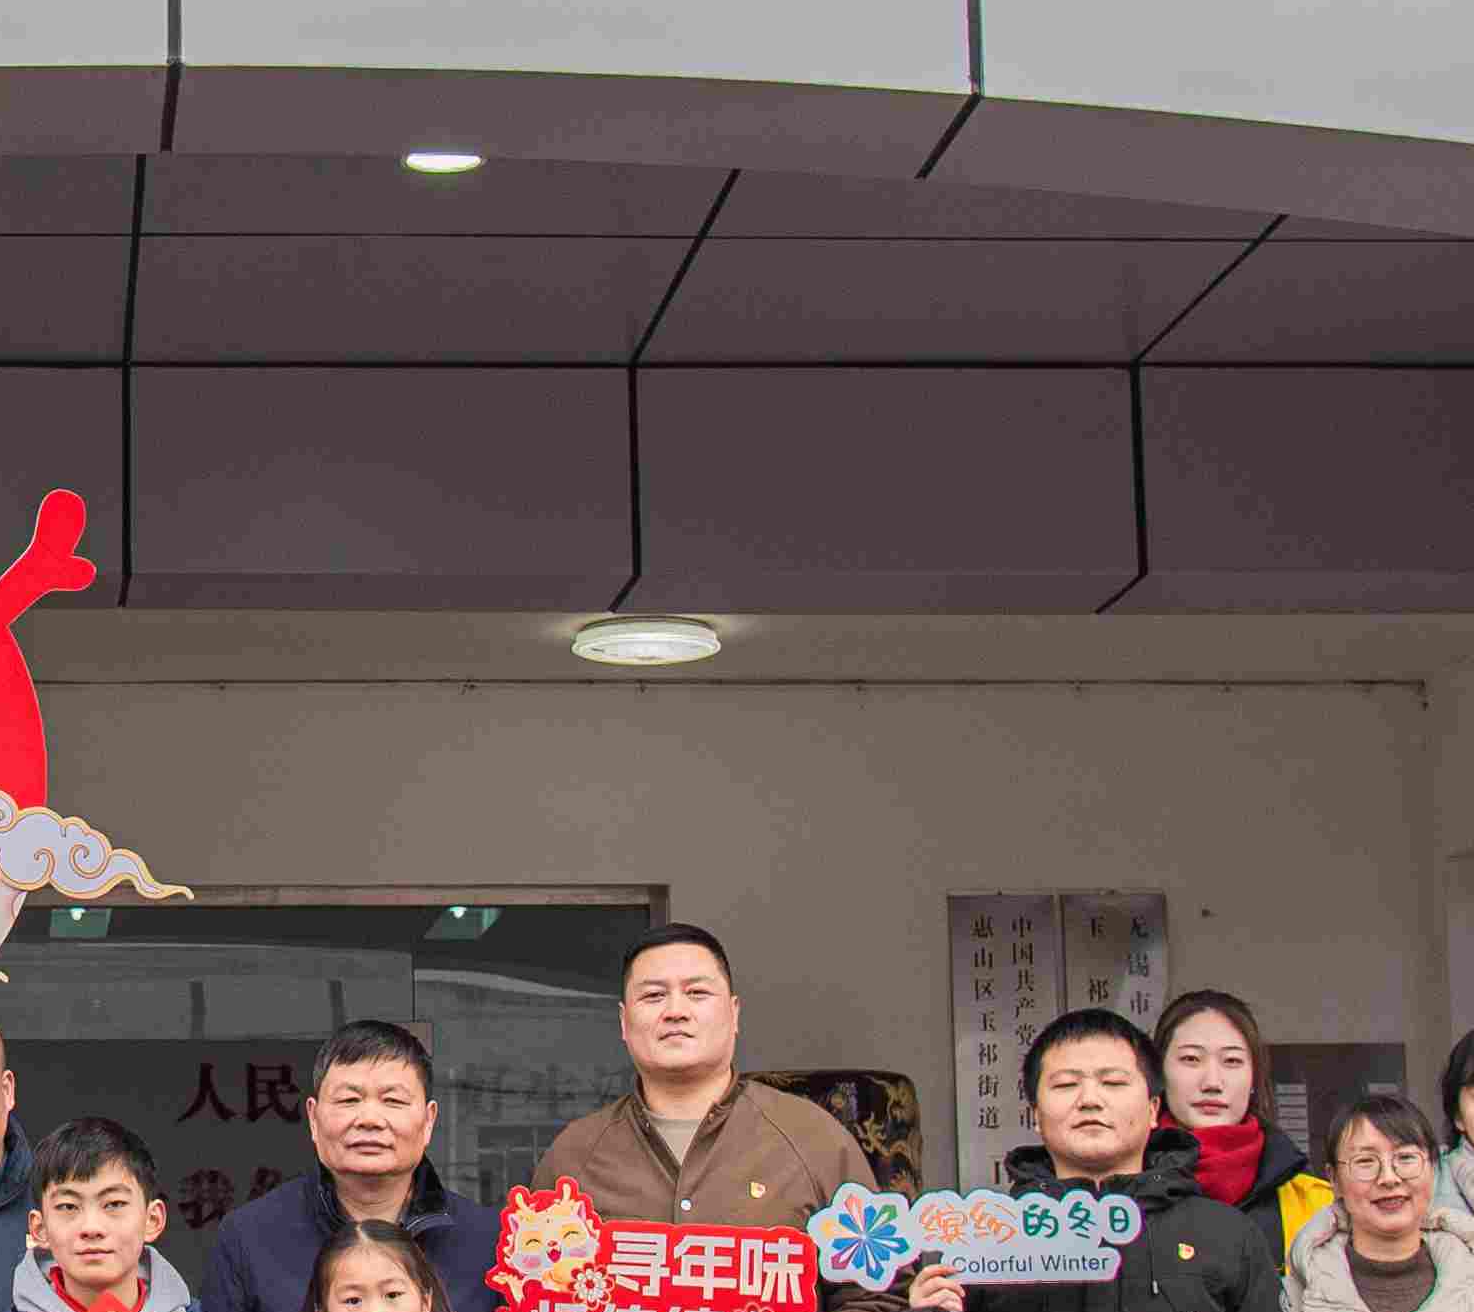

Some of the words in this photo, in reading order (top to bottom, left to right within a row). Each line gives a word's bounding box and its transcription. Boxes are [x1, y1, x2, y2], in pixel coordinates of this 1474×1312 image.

[174, 1062, 300, 1123] 人民
[921, 1199, 1132, 1243] 缤纷的冬日
[606, 1230, 805, 1304] 寻年味
[952, 1253, 1035, 1275] Colorful
[1040, 1251, 1112, 1273] Winter
